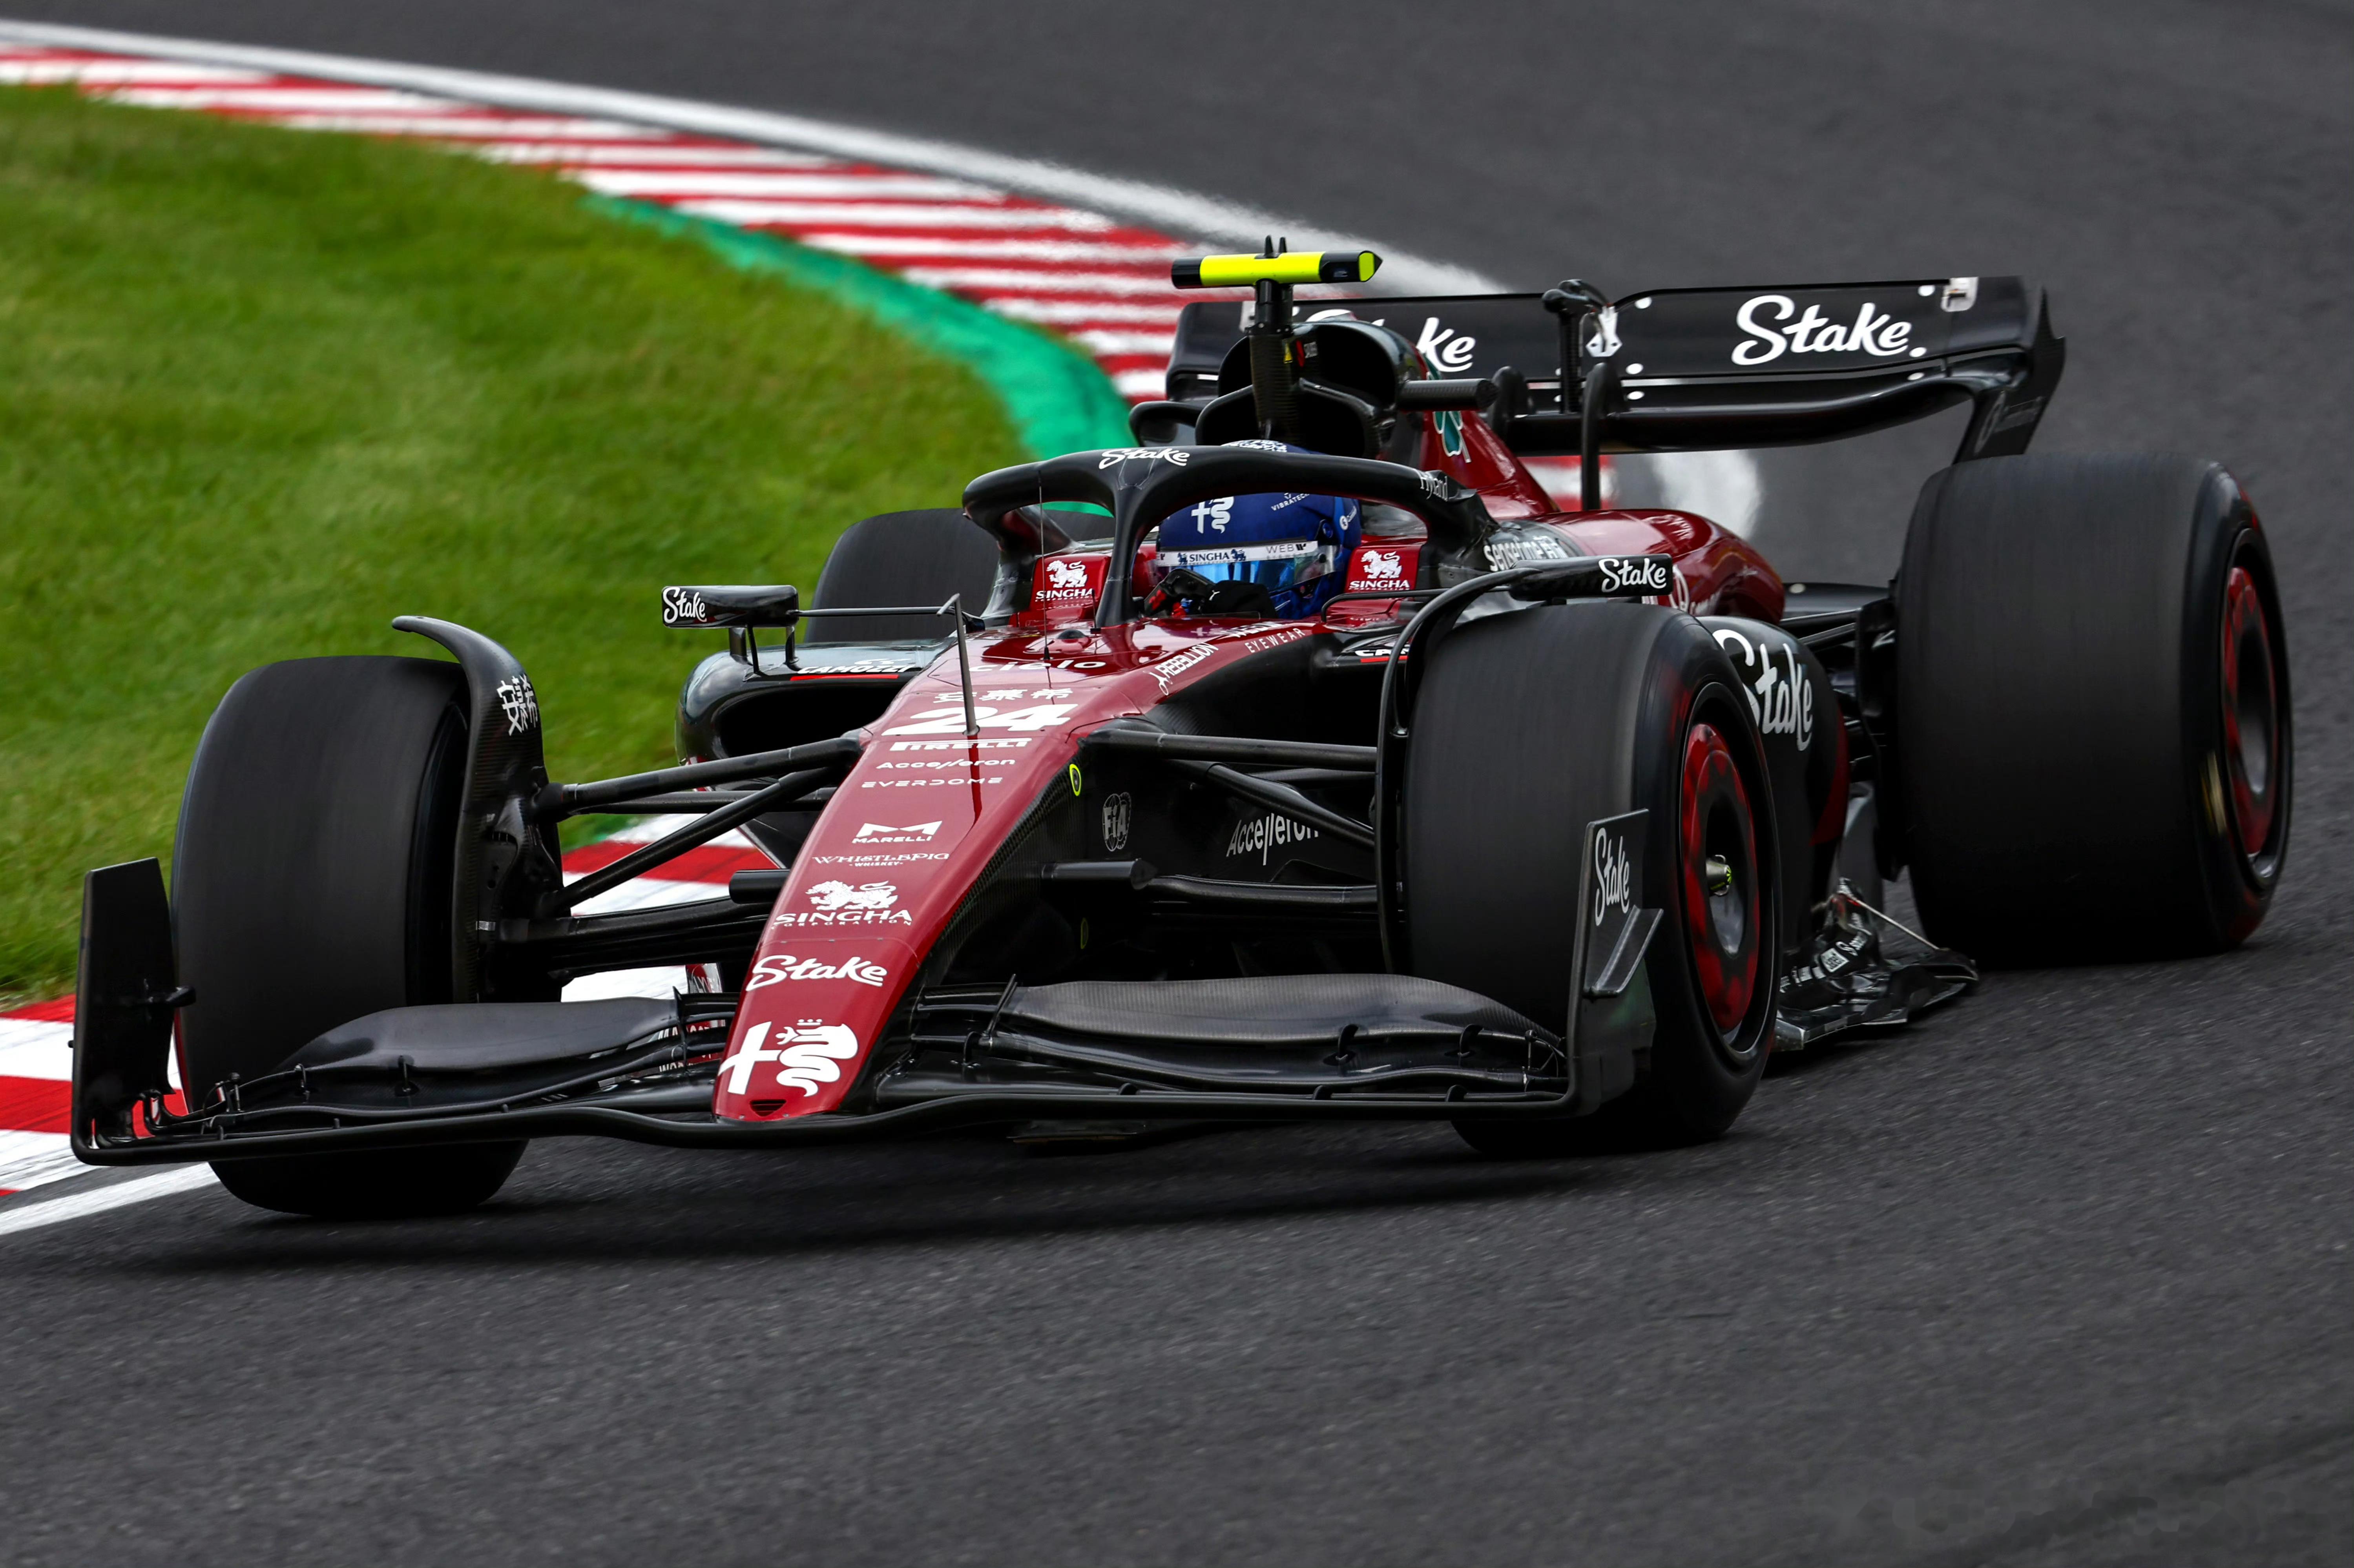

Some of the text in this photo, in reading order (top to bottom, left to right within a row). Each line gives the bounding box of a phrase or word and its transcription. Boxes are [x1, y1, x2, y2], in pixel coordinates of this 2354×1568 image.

[1731, 294, 1912, 366] Stake
[1099, 448, 1190, 469] Stake
[1190, 552, 1230, 562] SINGHA
[1349, 580, 1410, 588] SINGHA
[1598, 558, 1666, 592] Stake
[1036, 589, 1093, 599] SINGHA
[662, 587, 707, 623] Stake
[1245, 628, 1305, 653] EYEWEAR
[797, 665, 914, 674] CAMOZZI
[969, 659, 1106, 672] cielo
[881, 704, 1078, 736] 24
[890, 738, 1032, 751] PIRELLI
[861, 777, 1003, 788] EVERDOME
[1595, 828, 1630, 926] Stake
[773, 910, 912, 925] SINGHA
[746, 955, 888, 992] Stake
